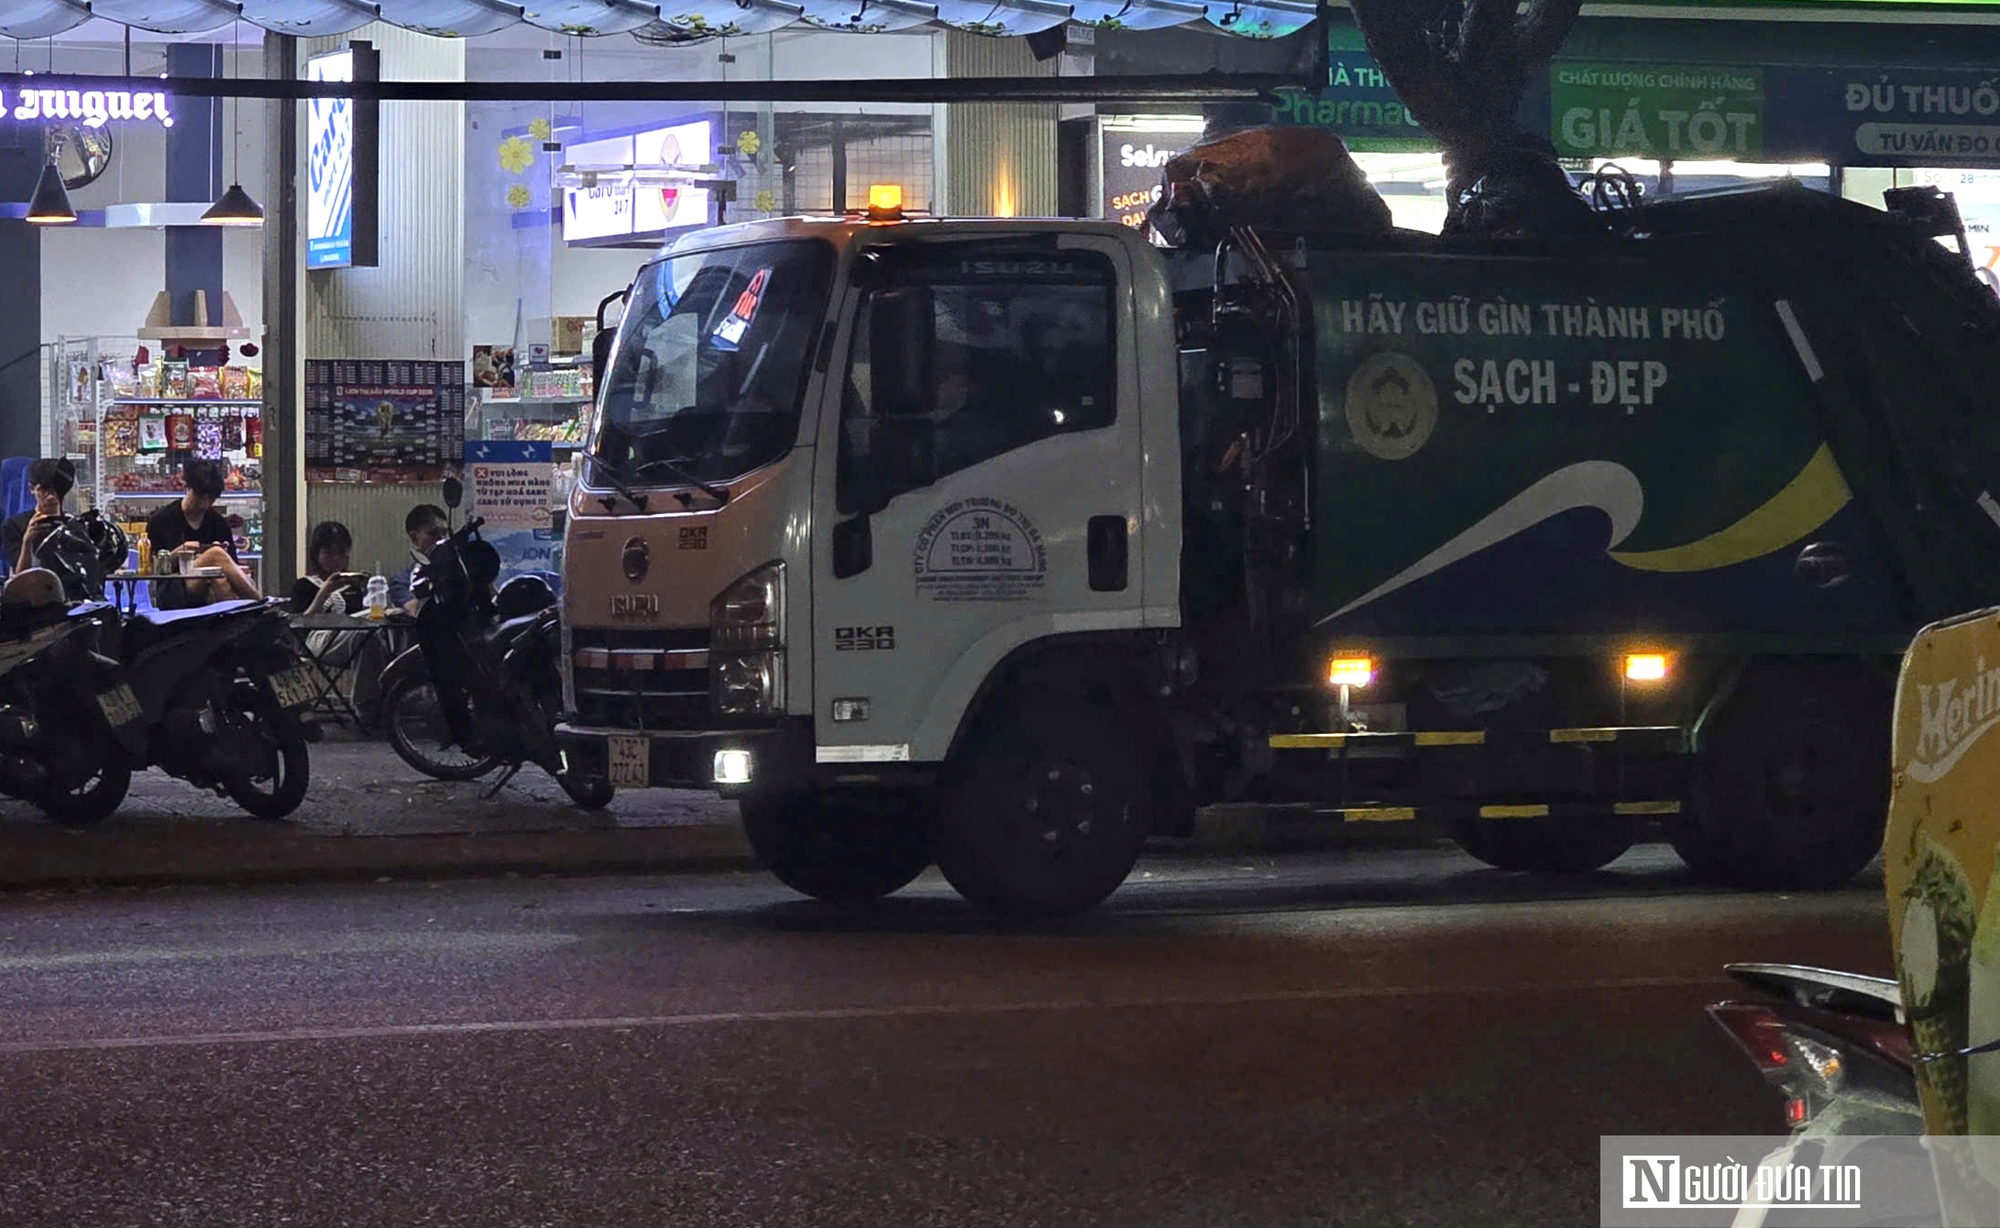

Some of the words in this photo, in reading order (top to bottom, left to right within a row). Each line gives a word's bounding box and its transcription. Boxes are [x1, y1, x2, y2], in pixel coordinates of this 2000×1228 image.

[1354, 67, 1392, 87] TH
[1559, 67, 1599, 86] CHẤT
[1846, 75, 1895, 113] ĐỦ
[1562, 98, 1650, 151] GIÁ
[1659, 97, 1757, 151] TỐT
[1910, 127, 1953, 152] VẤN
[961, 260, 1076, 275] ISUZU
[1341, 293, 1406, 334] HÃY
[1416, 295, 1470, 335] GIỮ
[1478, 297, 1531, 335] GÌN
[1541, 297, 1651, 340] THÀNH
[1662, 297, 1726, 342] PHỐ
[1454, 359, 1556, 414] SẠCH
[1591, 360, 1668, 415] ĐẸP
[506, 468, 528, 477] LÒNG
[476, 478, 506, 486] KHÔNG
[528, 478, 550, 486] HÀNG
[680, 526, 707, 538] QKR
[679, 538, 707, 549] 230
[835, 626, 894, 639] QKR
[835, 638, 895, 650] 230
